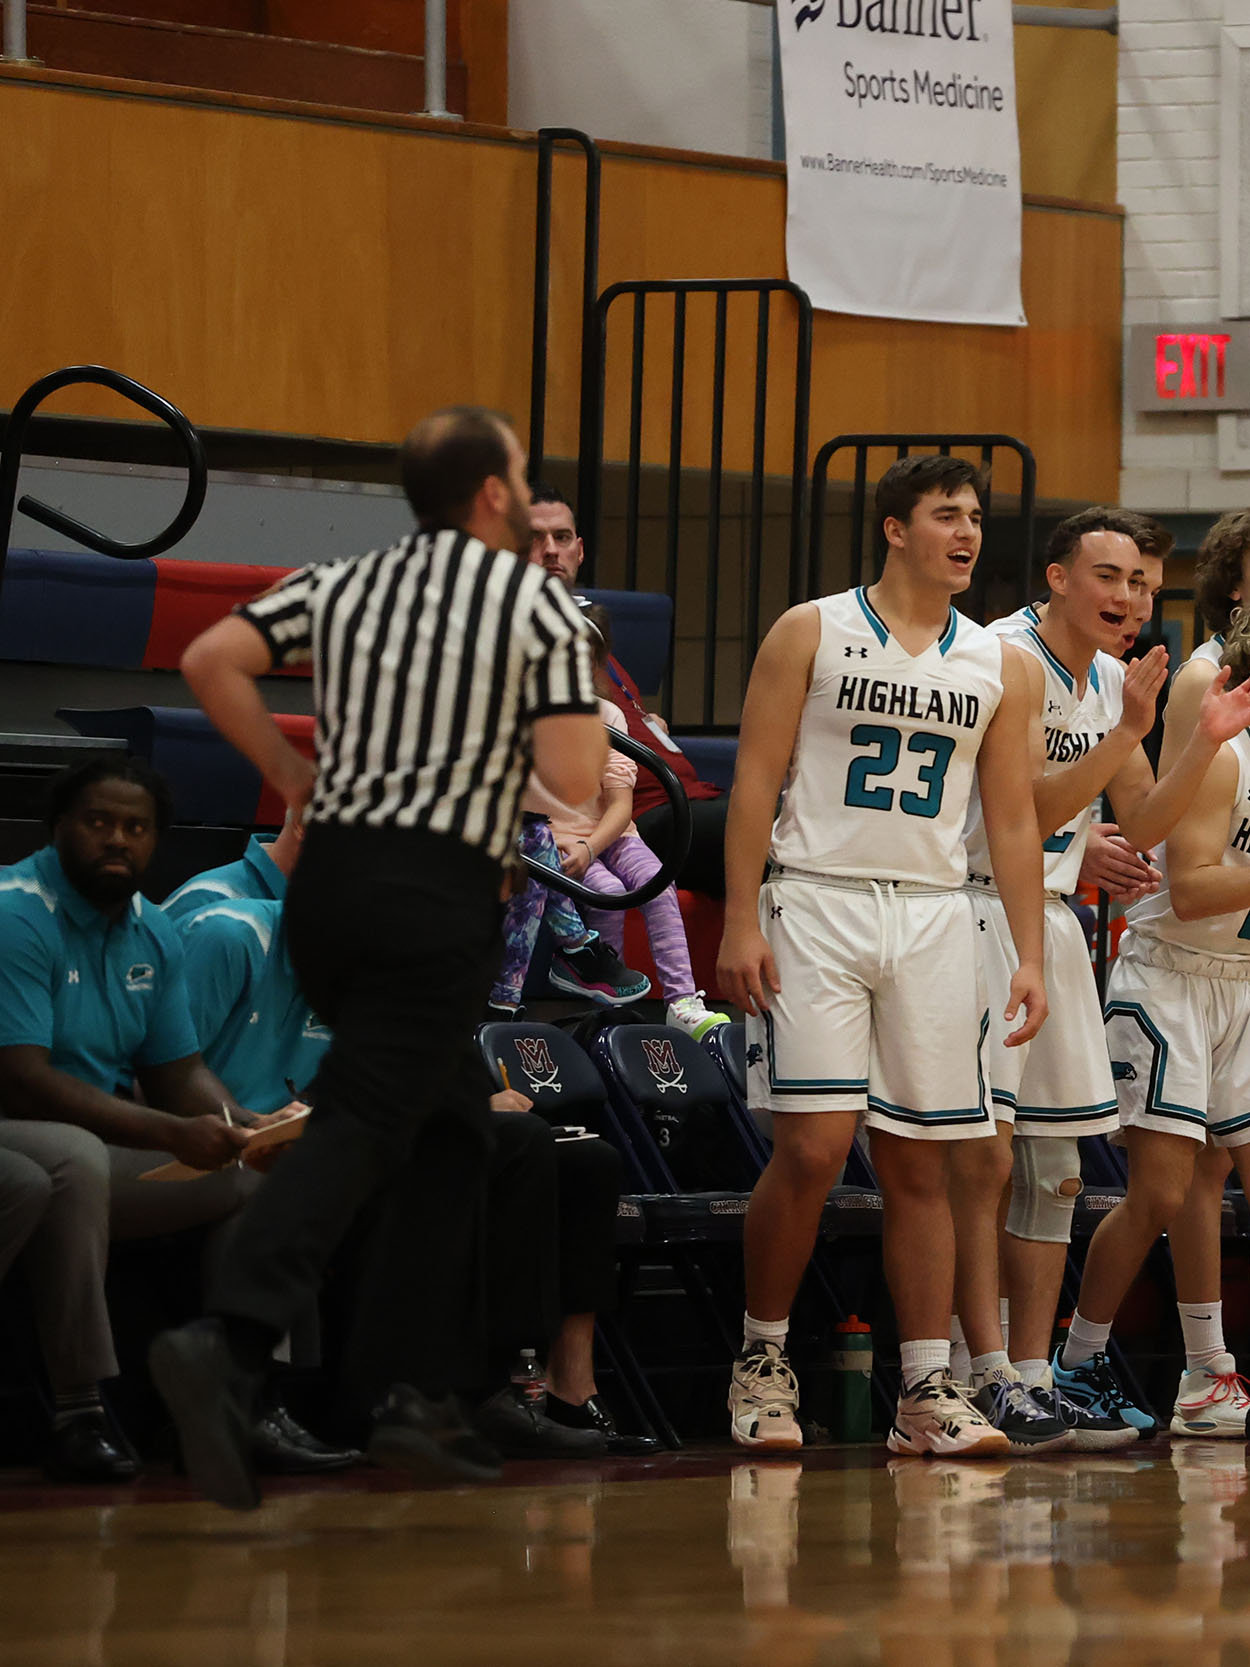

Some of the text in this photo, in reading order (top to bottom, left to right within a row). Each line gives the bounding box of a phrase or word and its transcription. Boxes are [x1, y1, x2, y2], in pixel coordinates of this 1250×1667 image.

[843, 61, 1004, 112] Sports Medicine
[801, 153, 1007, 188] www.BannerHealth.com/SportsMedicine
[1155, 333, 1231, 399] EXIT
[837, 676, 980, 729] HIGHLAND
[844, 723, 956, 819] 23
